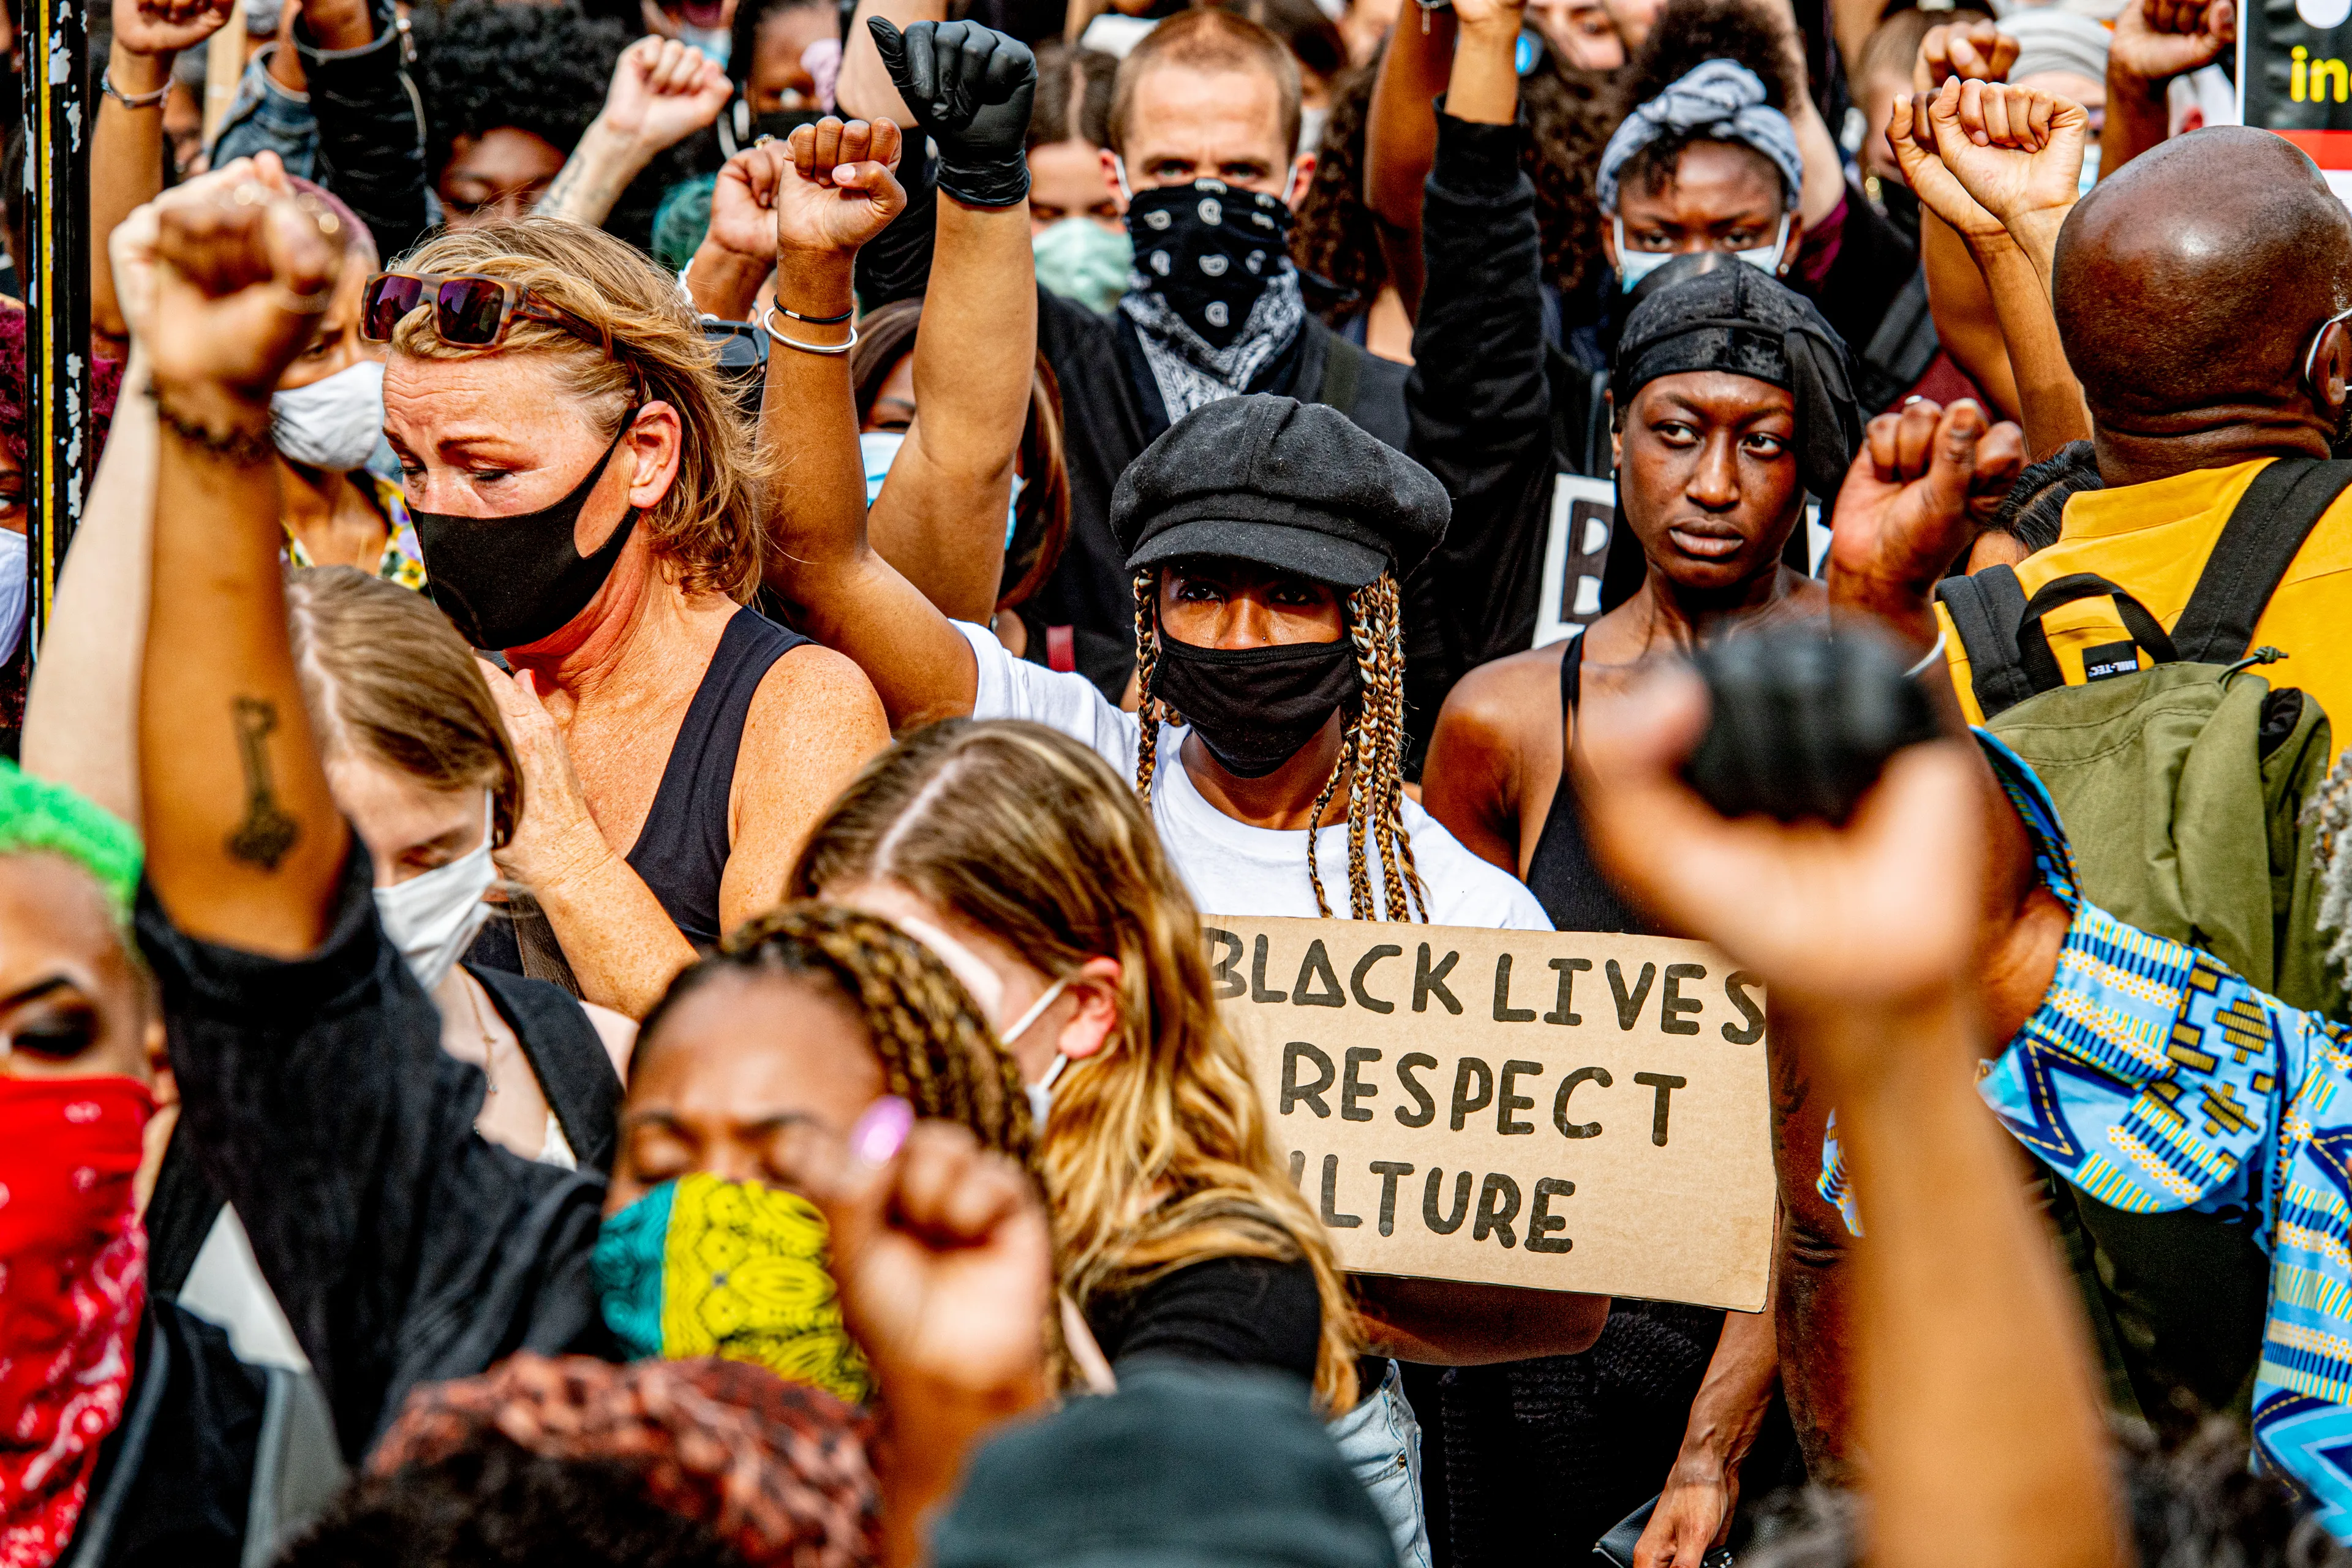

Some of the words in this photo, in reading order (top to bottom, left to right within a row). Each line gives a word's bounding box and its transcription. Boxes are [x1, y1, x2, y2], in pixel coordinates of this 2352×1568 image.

[2290, 45, 2352, 103] in
[1202, 927, 1463, 1015] BLACK
[1493, 953, 1766, 1045] LIVES
[1280, 1042, 1687, 1146] RESPECT
[1289, 1150, 1576, 1254] LTURE
